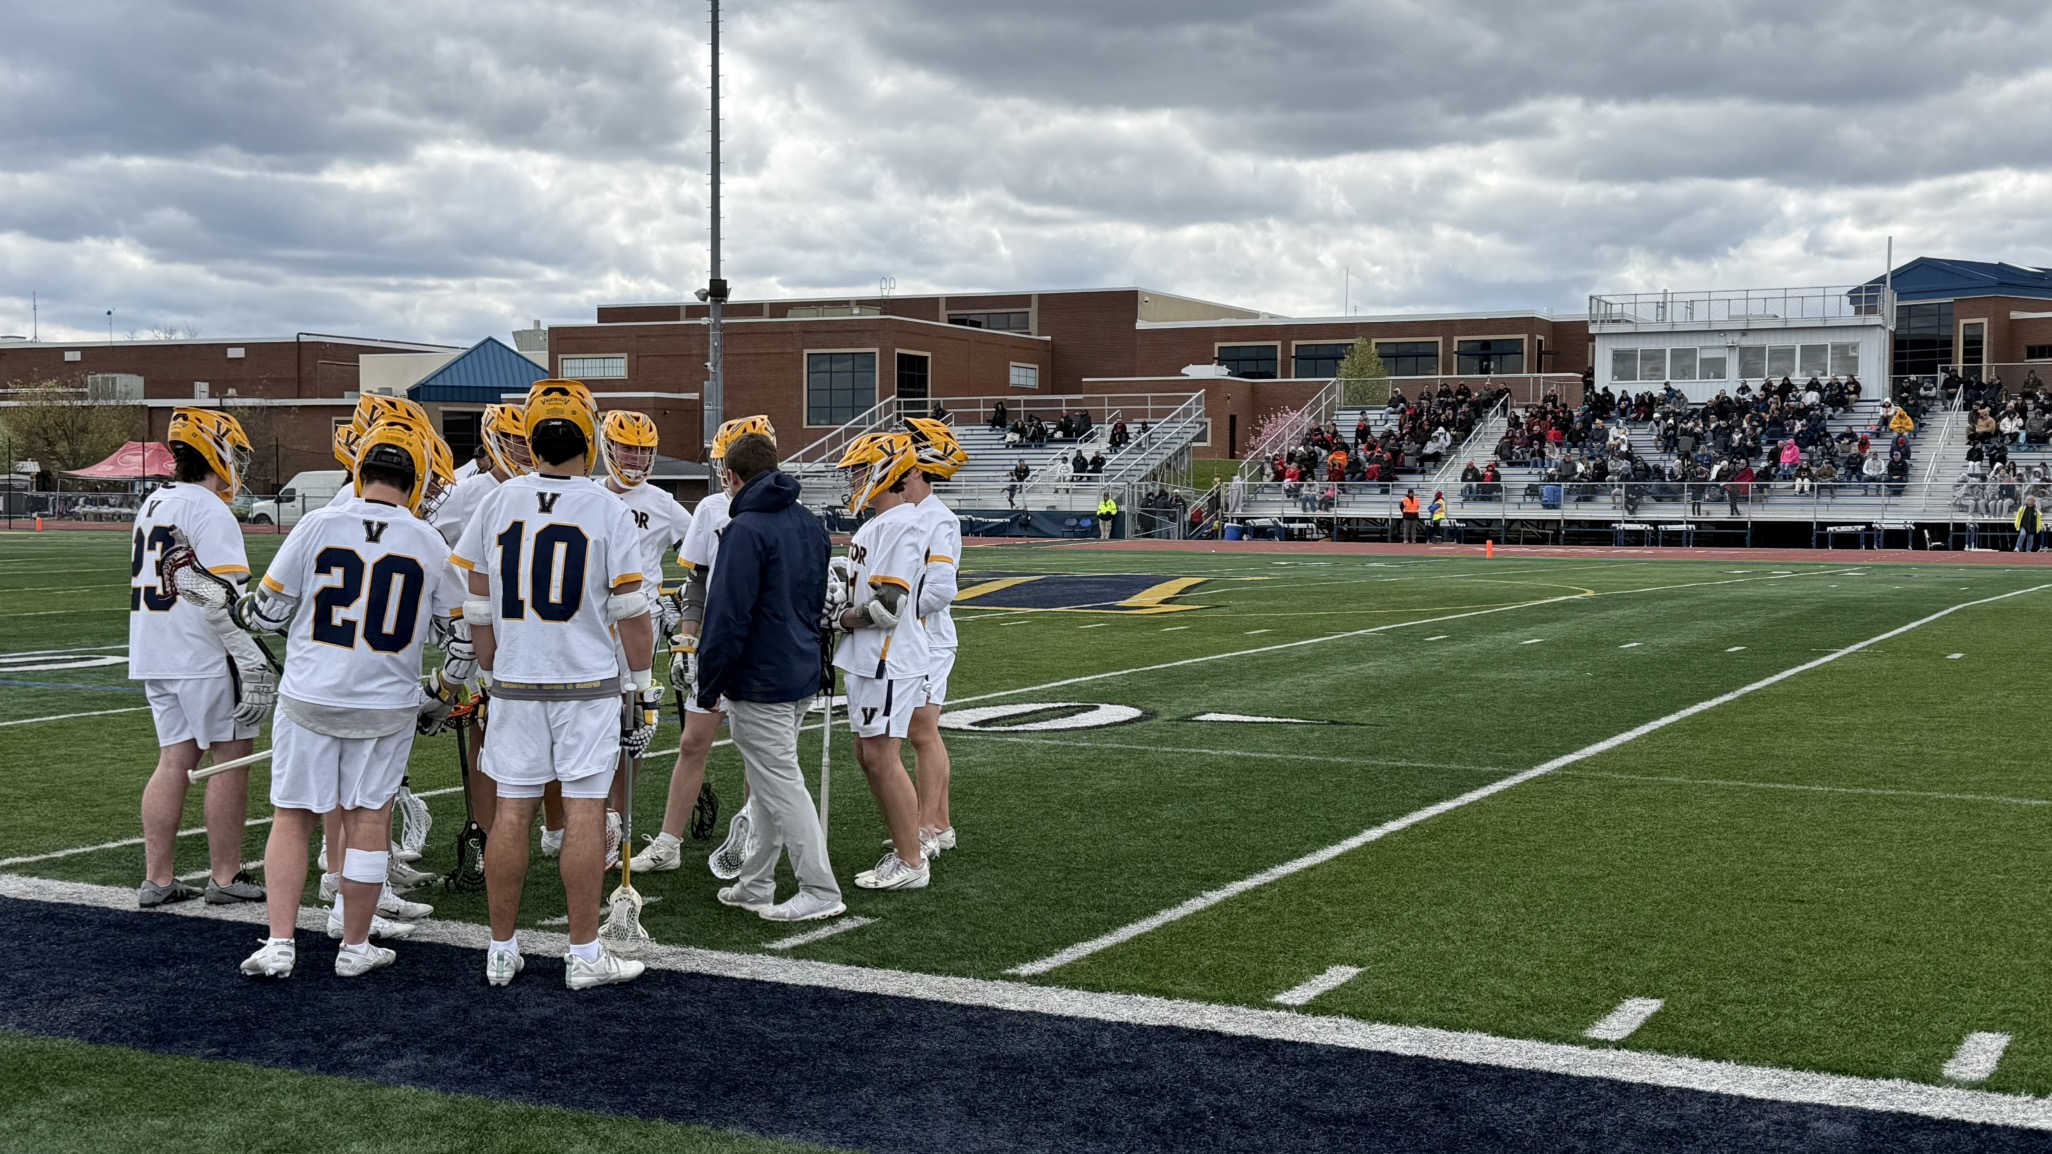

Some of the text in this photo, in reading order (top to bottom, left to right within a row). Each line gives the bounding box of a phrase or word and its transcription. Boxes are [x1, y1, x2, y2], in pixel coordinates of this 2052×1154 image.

[369, 404, 385, 423] V
[215, 419, 233, 441] V
[876, 438, 896, 458] V
[942, 442, 958, 457] V
[146, 500, 163, 518] V
[536, 491, 562, 514] V
[631, 509, 649, 530] OR
[362, 519, 389, 544] V
[495, 519, 591, 624] 10
[311, 545, 425, 655] 20
[861, 707, 878, 725] V
[650, 855, 663, 864] N
